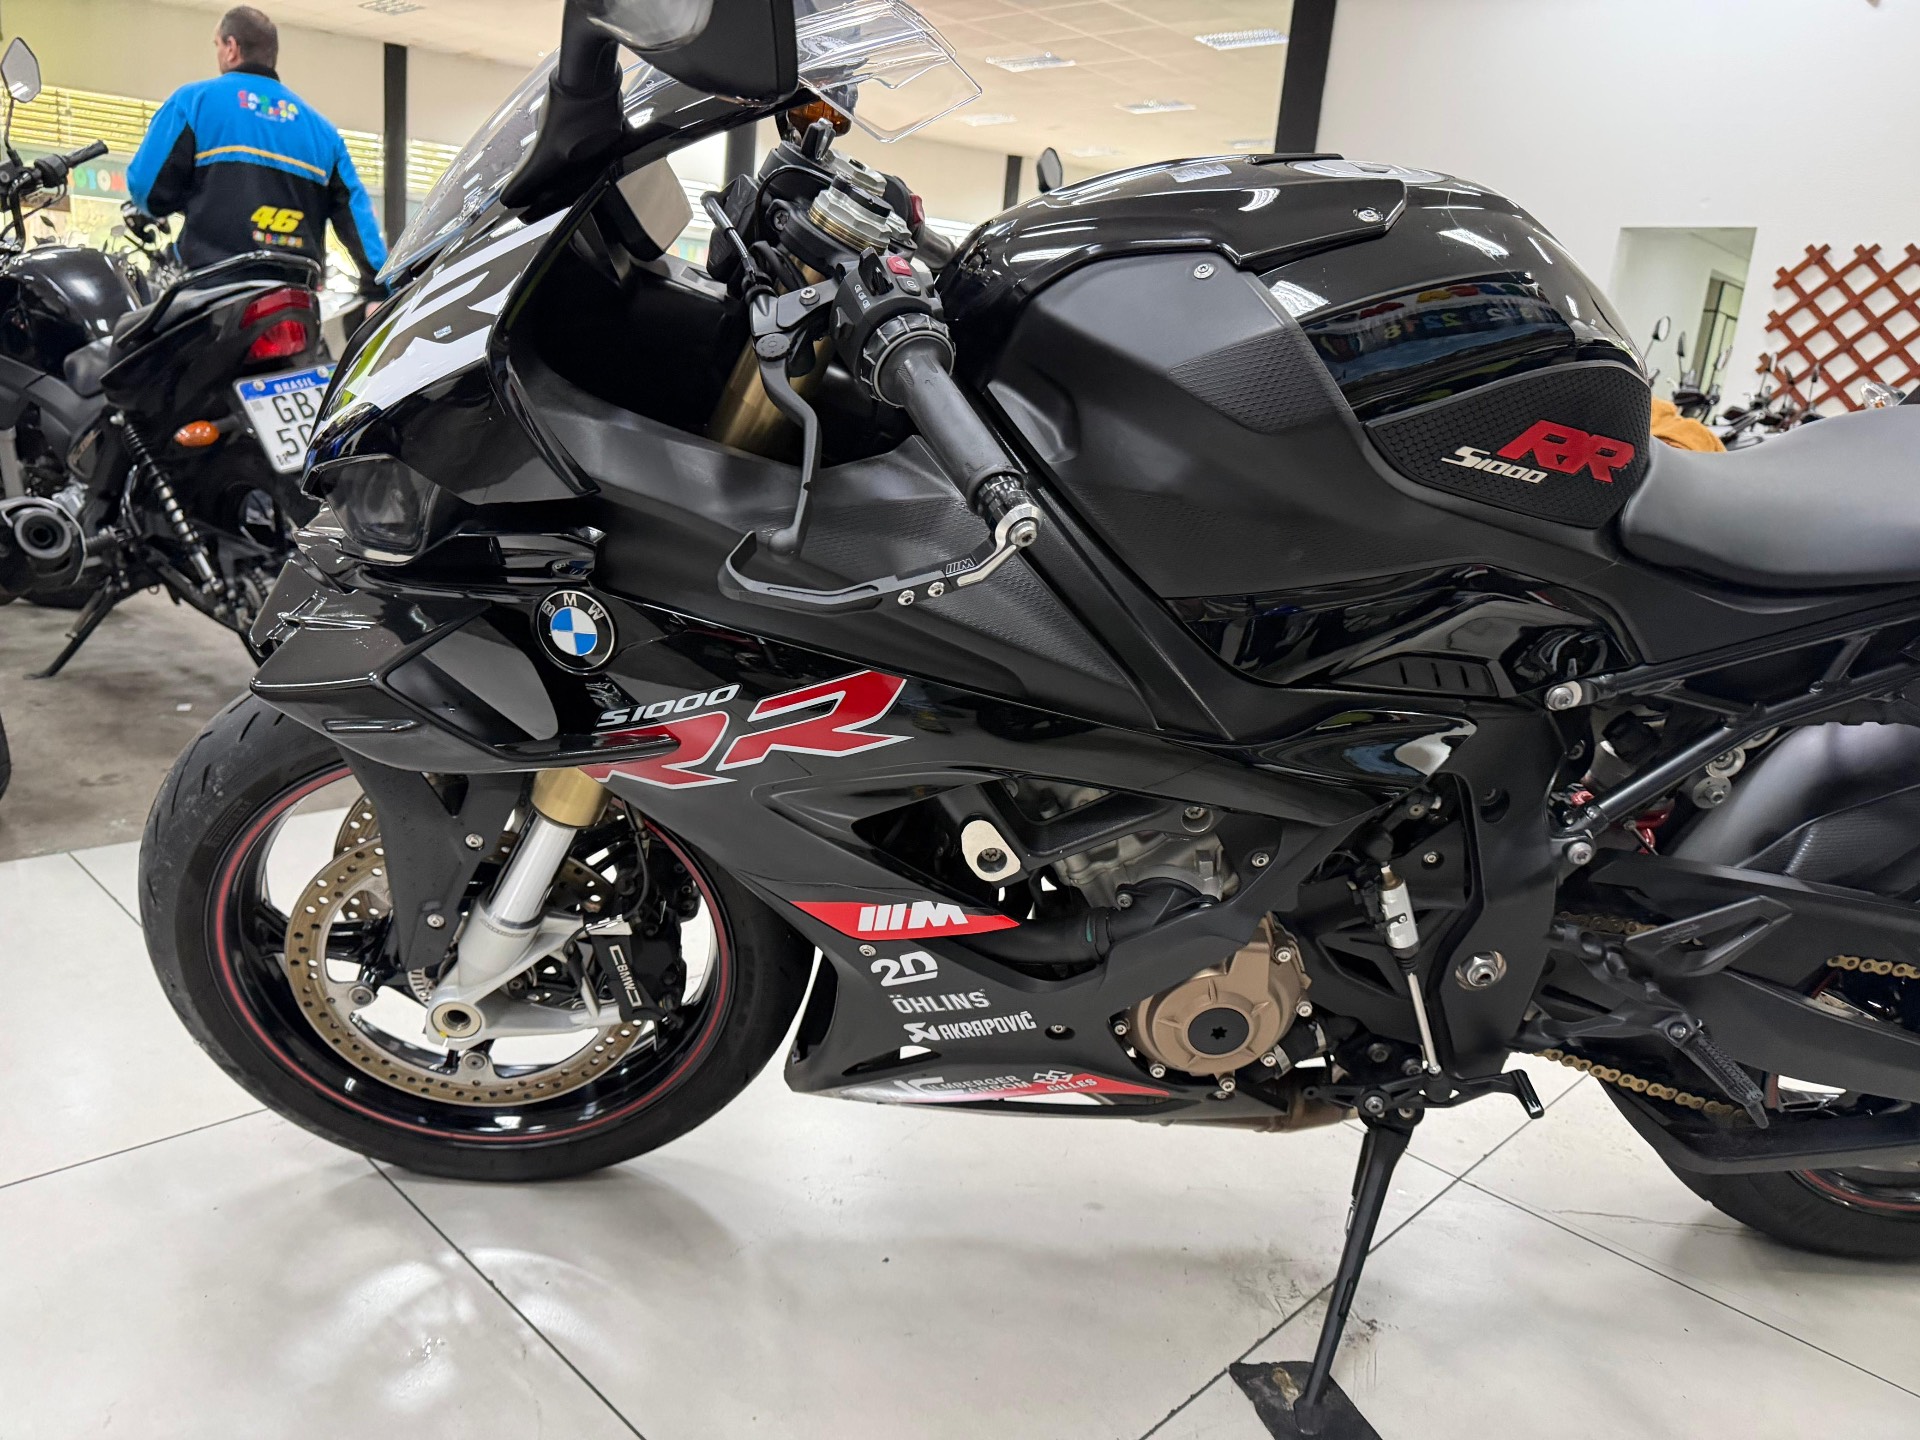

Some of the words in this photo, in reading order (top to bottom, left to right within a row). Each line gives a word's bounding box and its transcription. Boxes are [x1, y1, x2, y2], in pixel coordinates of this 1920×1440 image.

[251, 205, 304, 233] 46
[274, 377, 316, 394] BRASIL
[1441, 446, 1548, 484] S1000
[1497, 420, 1635, 483] RR
[541, 592, 605, 621] BMW
[598, 684, 742, 727] S1000
[616, 964, 636, 990] BMW
[888, 991, 991, 1014] ÖHLINS
[1046, 1078, 1098, 1093] GILLES
